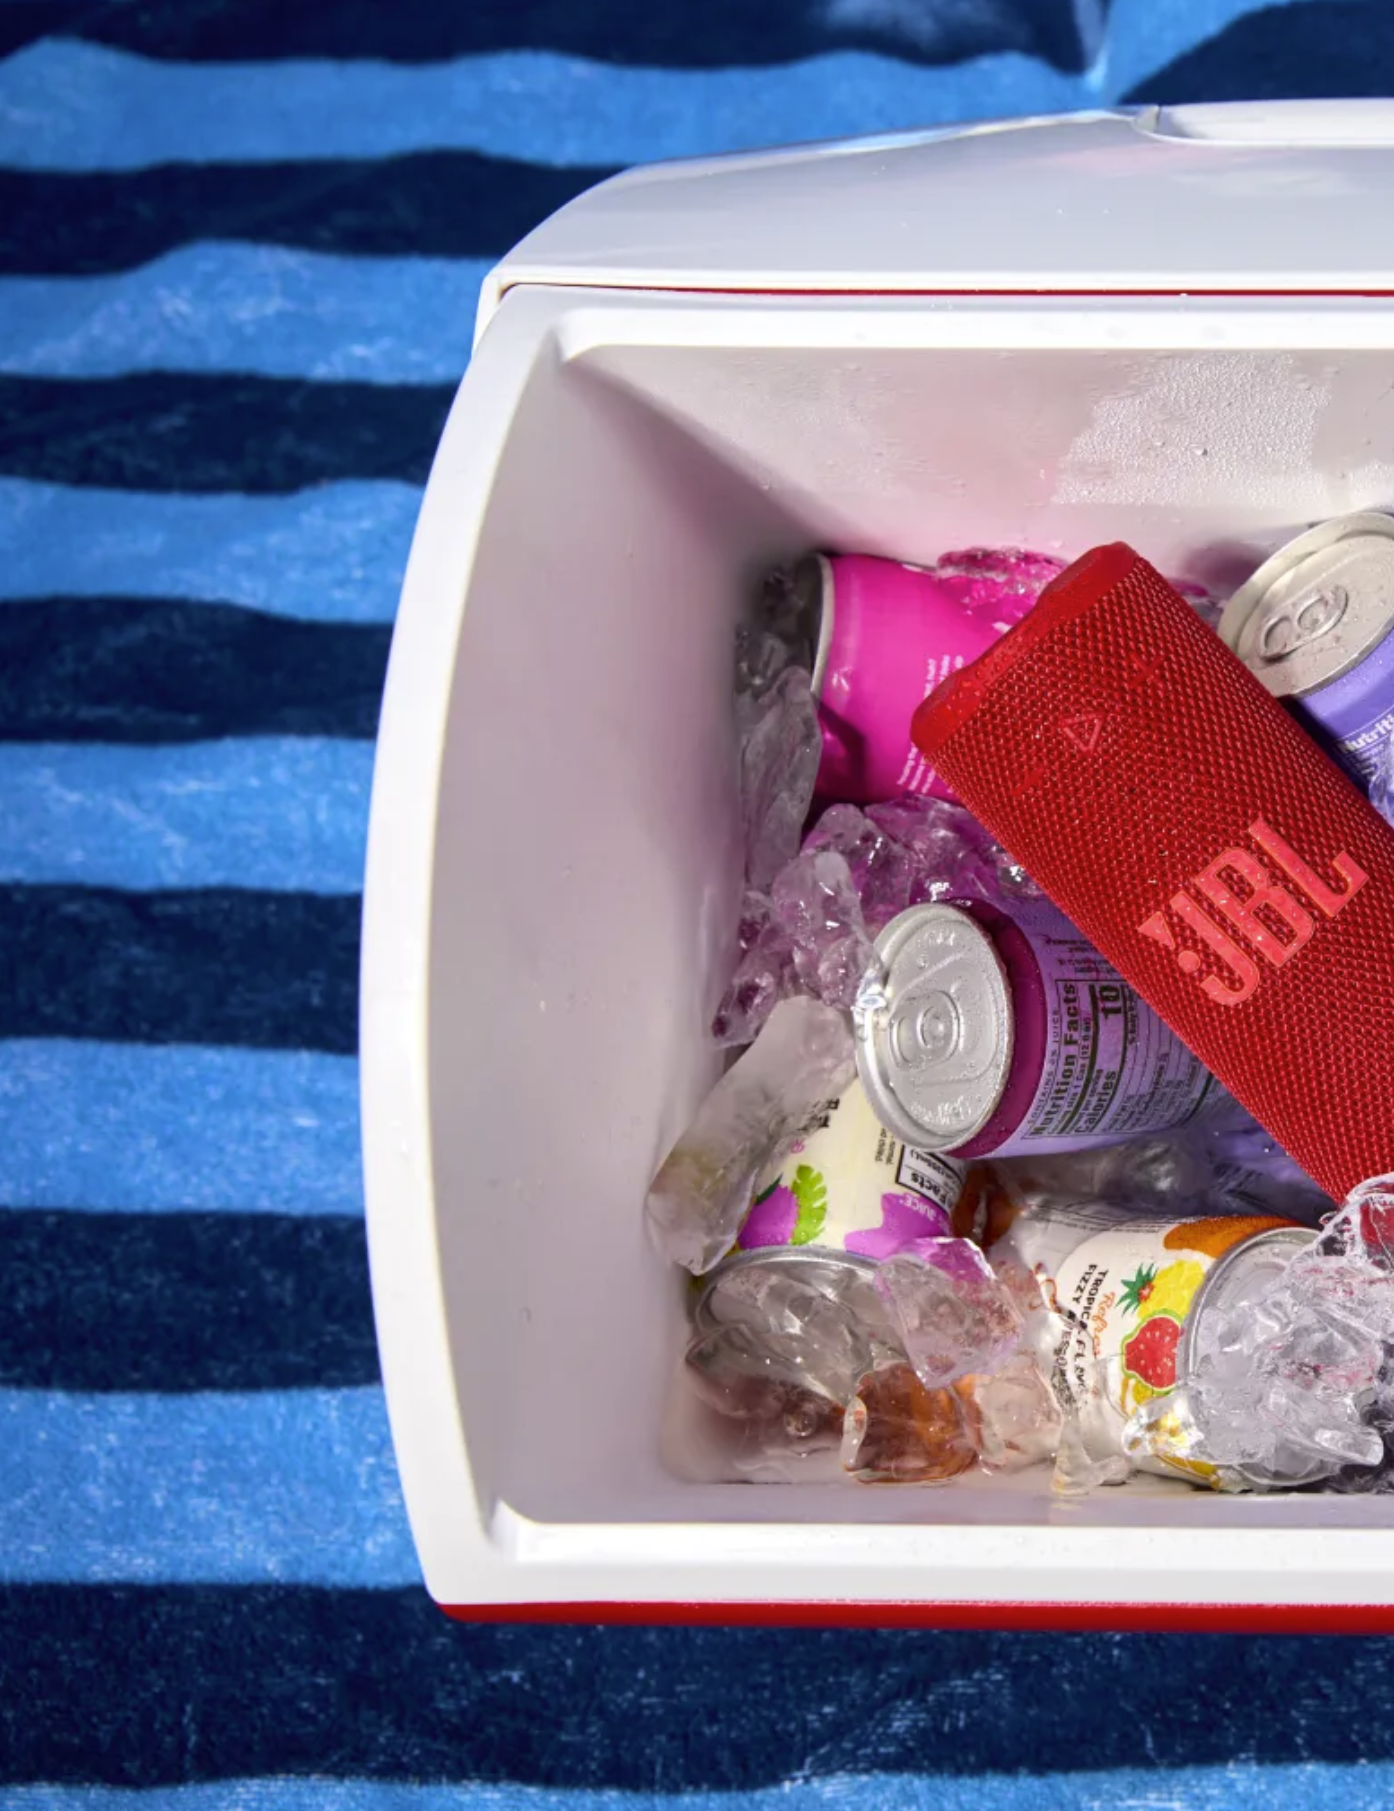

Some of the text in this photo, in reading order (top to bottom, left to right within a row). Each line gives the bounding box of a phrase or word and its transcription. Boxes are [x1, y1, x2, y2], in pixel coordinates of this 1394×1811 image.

[1169, 817, 1369, 1006] JBL
[1052, 1009, 1060, 1044] JUICE
[1029, 1054, 1077, 1136] Nutrition
[1063, 983, 1079, 1046] Facts
[1074, 1070, 1117, 1134] Calories
[1100, 984, 1122, 1020] 10
[910, 1172, 947, 1205] Facts
[1072, 1264, 1098, 1304] FIZZY
[1079, 1269, 1109, 1333] TROPIC
